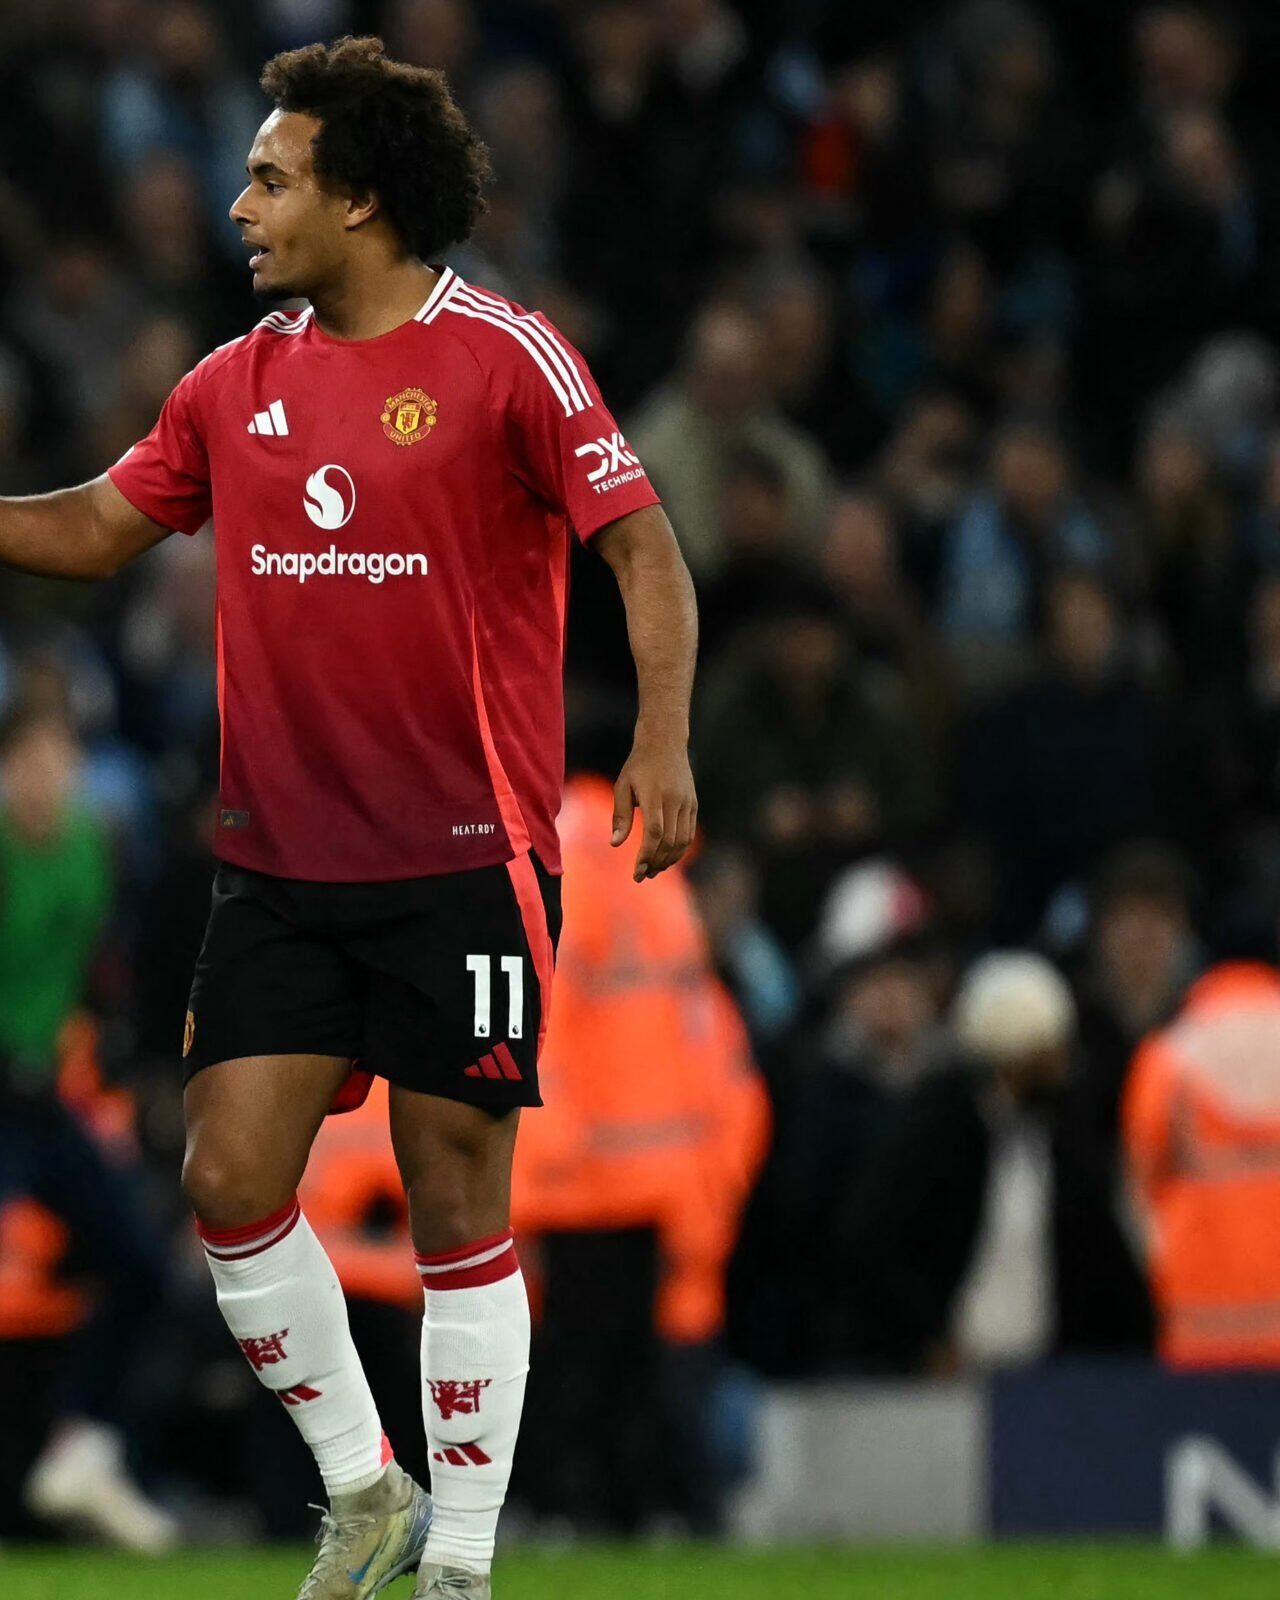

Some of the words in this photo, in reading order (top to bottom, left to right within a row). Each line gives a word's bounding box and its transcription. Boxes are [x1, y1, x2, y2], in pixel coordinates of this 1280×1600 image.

[387, 391, 433, 412] MANCHESTER
[390, 431, 421, 442] UNITED
[592, 467, 646, 494] TECHNOLOG
[251, 544, 428, 584] Snapdragon
[452, 823, 495, 836] HEAT.RDY
[466, 954, 523, 1039] 11
